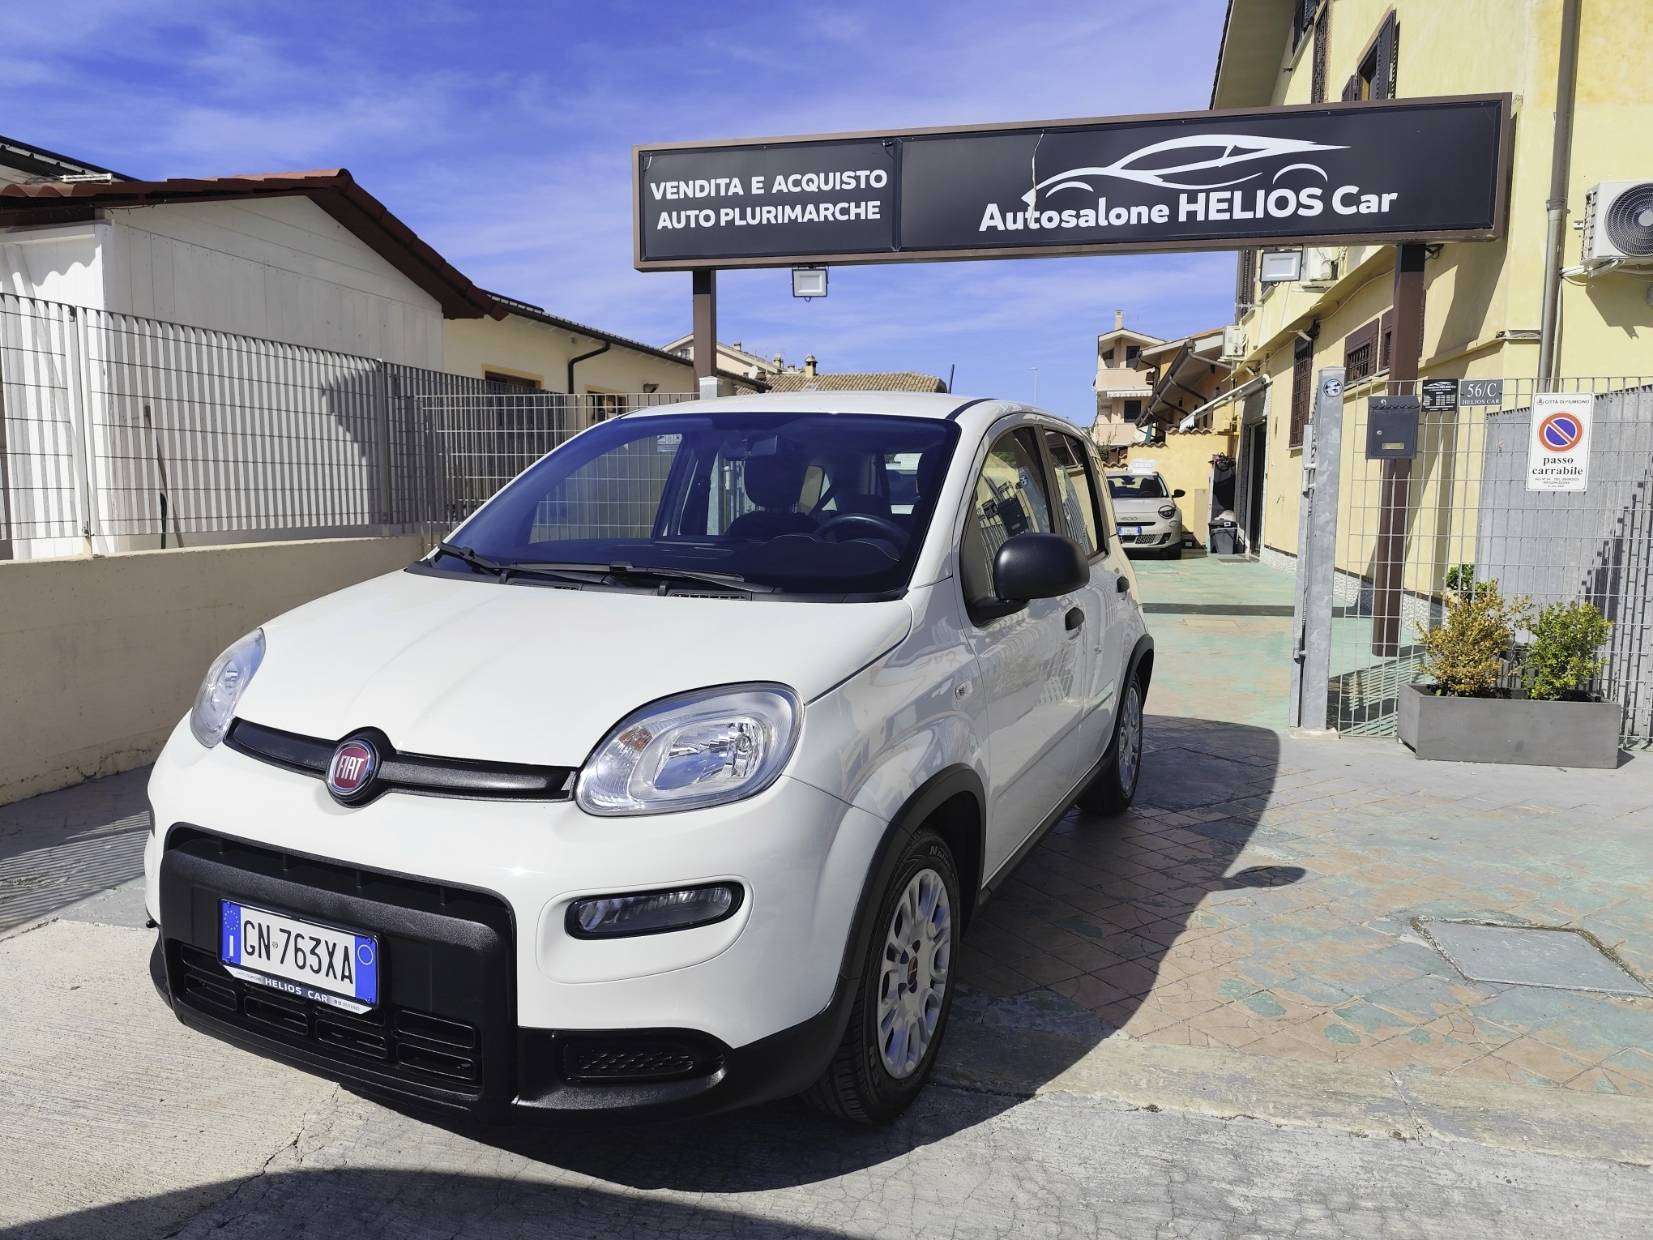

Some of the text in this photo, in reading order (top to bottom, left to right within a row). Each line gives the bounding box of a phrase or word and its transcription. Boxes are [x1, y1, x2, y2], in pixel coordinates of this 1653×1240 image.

[650, 169, 888, 200] VENDITA E ACQUISTO
[657, 200, 881, 230] AUTO PLURIMARCHE
[979, 185, 1399, 232] Autosalone HELIOS Car
[1467, 382, 1497, 398] 56/C
[1532, 466, 1583, 475] carrabile
[1543, 457, 1574, 466] passo
[335, 755, 364, 780] FIAT
[265, 978, 328, 1004] HELIOS CAR
